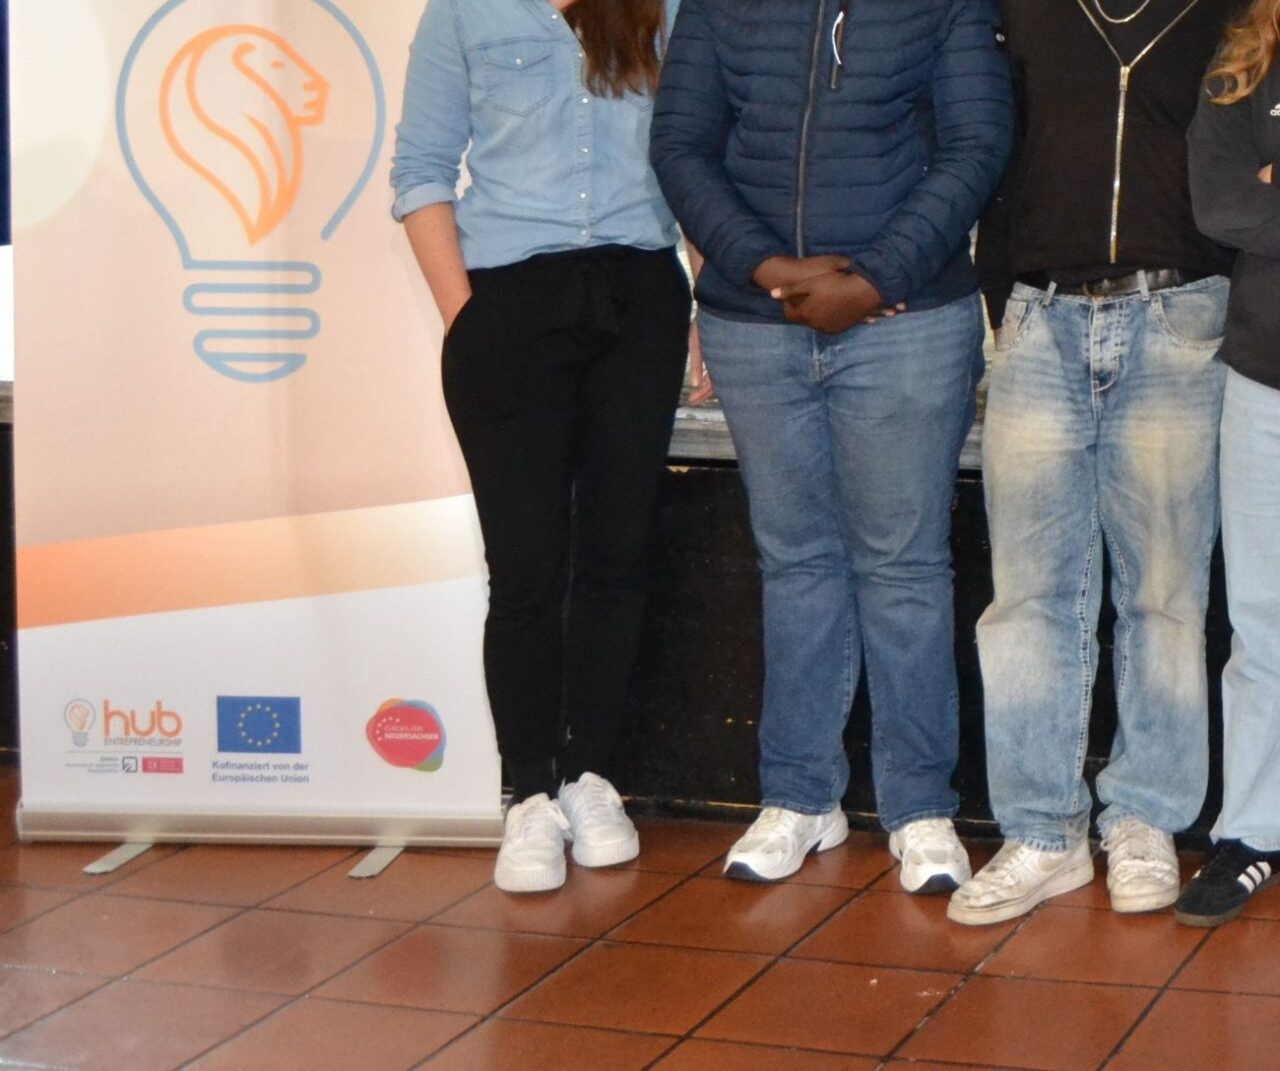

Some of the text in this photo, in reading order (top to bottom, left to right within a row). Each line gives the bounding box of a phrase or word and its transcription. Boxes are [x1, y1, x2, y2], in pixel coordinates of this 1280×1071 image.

[103, 699, 183, 737] hub
[103, 736, 183, 747] ENTREPRENEURSHIP
[211, 760, 309, 771] Kofinanziert von der
[211, 772, 310, 784] Europäischen Union
